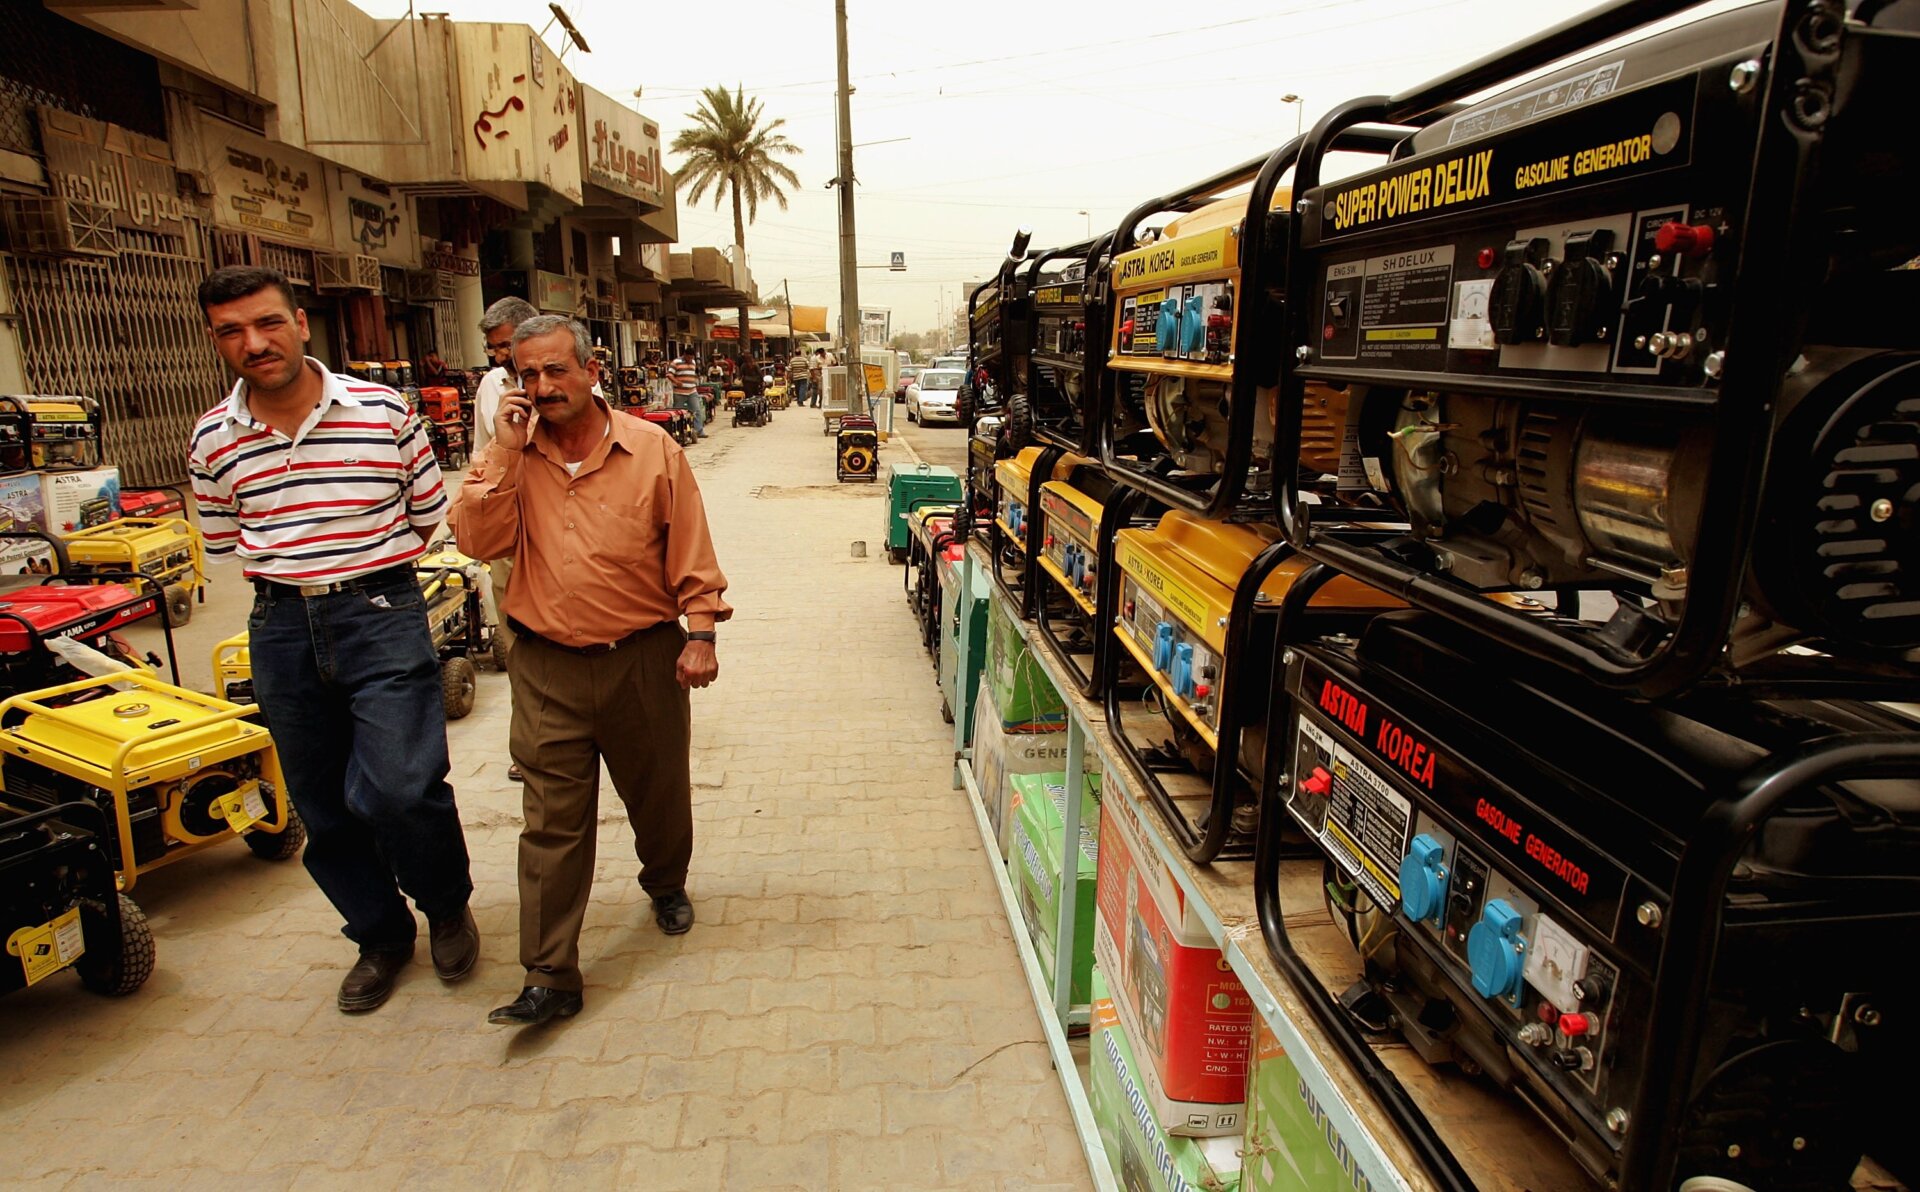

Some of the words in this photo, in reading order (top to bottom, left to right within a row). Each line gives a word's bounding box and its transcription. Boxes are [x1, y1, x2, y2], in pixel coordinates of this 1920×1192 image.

[1515, 155, 1568, 190] GASOLINE
[1573, 134, 1651, 177] GENERATOR
[1335, 179, 1378, 230] SUPER
[1378, 163, 1430, 221] POWER
[1433, 149, 1493, 208] DELUX
[1694, 210, 1705, 219] DC
[1709, 208, 1723, 217] 12V
[1122, 256, 1146, 280] ASTRA
[1149, 249, 1175, 274] KOREA
[1180, 255, 1196, 267] GASOLINE
[1197, 249, 1218, 264] GENERATOR
[1383, 259, 1396, 271] SH
[1398, 251, 1435, 268] DELUX
[1327, 291, 1335, 300] ON
[55, 475, 82, 484] ASTRA
[8, 490, 28, 500] ASTRA
[1128, 554, 1143, 574] ASTRA
[1145, 568, 1164, 592] KOREA
[61, 625, 84, 637] KAMA
[1320, 678, 1367, 736] ASTRA
[1377, 718, 1436, 789] KOREA
[1350, 759, 1372, 783] ASTRA
[1373, 778, 1389, 797] 3700
[1476, 798, 1520, 845] GASOLINE
[1525, 833, 1589, 895] GENERATOR
[1209, 1024, 1237, 1032] RATED
[1205, 1064, 1230, 1073] C/NO:
[1104, 1029, 1127, 1083] SUPER
[1125, 1076, 1158, 1156] POWER
